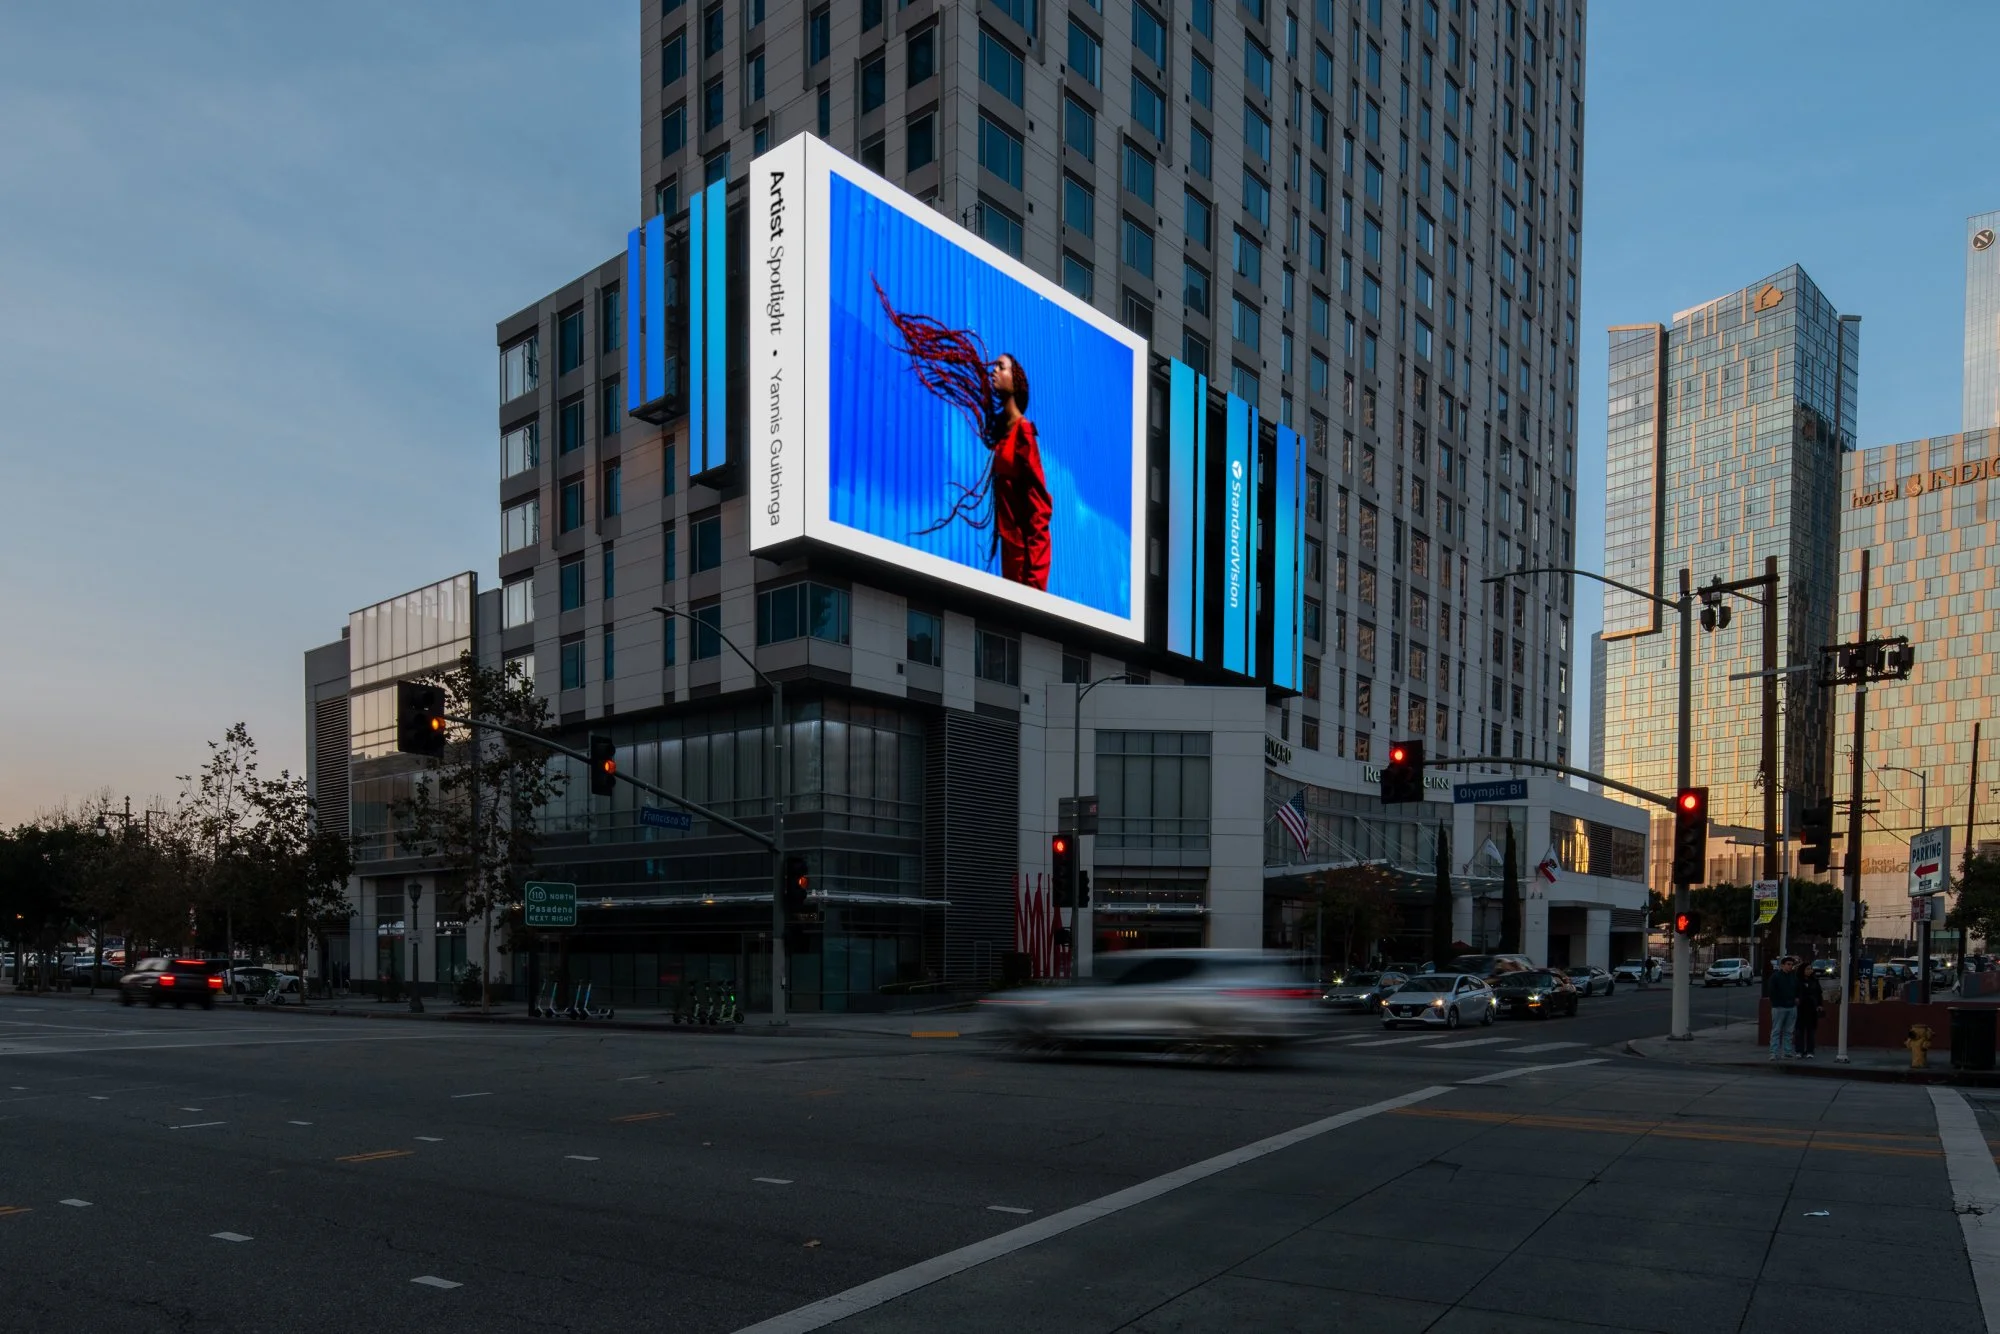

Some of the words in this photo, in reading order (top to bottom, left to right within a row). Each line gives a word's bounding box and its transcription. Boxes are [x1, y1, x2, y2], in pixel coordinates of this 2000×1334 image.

[769, 171, 786, 242] Artist
[766, 245, 786, 335] Spotlight
[769, 367, 783, 435] Yannis
[767, 439, 783, 526] Guibinga
[1852, 483, 1899, 508] hotel
[1230, 479, 1243, 608] StandardVision
[1432, 776, 1450, 789] INN
[1460, 787, 1506, 799] Olympic
[643, 810, 679, 825] Francisco
[680, 816, 689, 827] St
[1871, 857, 1895, 866] hotel
[1912, 842, 1941, 864] PARKING
[532, 891, 544, 900] 110
[549, 893, 574, 901] NORTH
[529, 904, 573, 913] Pasadena
[551, 915, 573, 923] RIGHT
